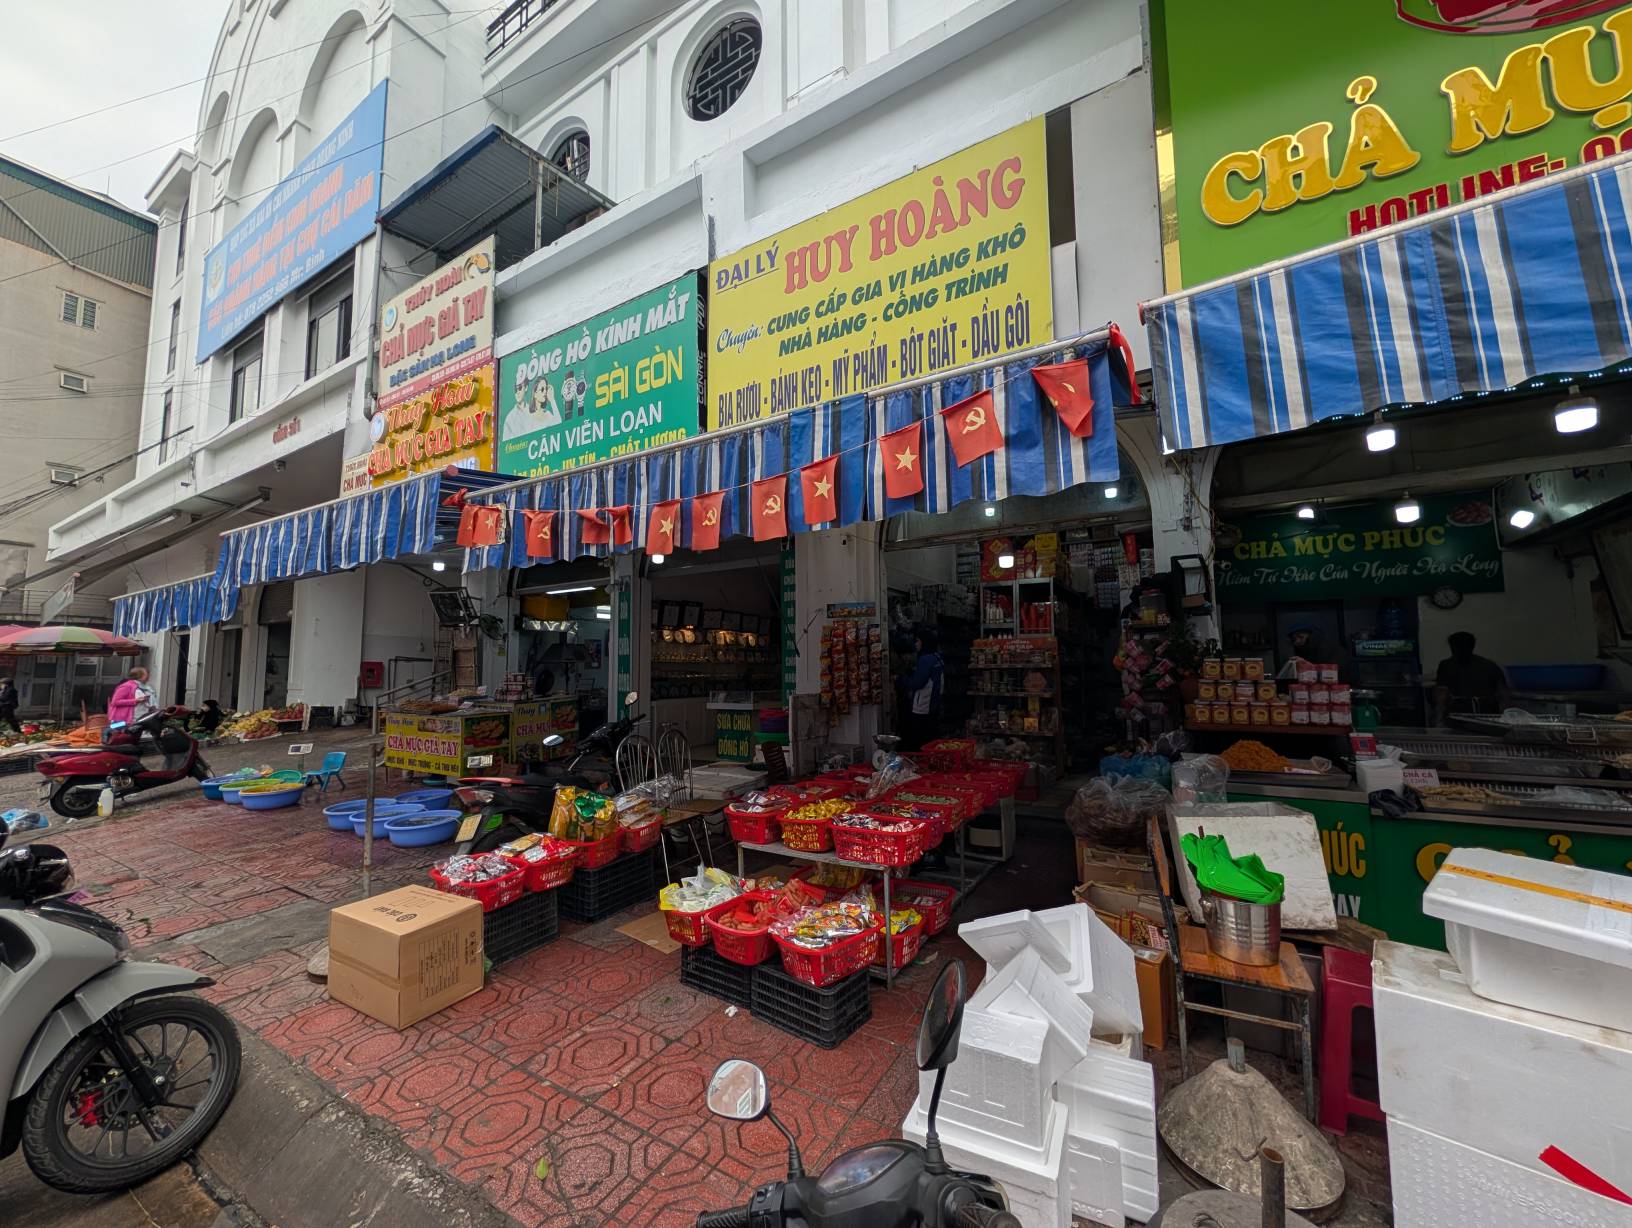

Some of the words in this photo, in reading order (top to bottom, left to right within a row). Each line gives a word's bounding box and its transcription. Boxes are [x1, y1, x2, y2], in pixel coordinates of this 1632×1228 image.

[1201, 75, 1421, 227] CHẢ
[784, 225, 859, 294] HUY
[868, 156, 1025, 261] HOÀNG
[715, 259, 750, 290] ĐẠI
[756, 240, 780, 274] LÝ
[767, 306, 810, 335] CUNG
[815, 287, 847, 318] CẤP
[851, 280, 882, 305] GIA
[889, 270, 907, 289] VỊ
[911, 248, 970, 285] HÀNG
[976, 222, 1026, 262] KHÔ
[382, 323, 405, 368] CHẢ
[407, 316, 436, 357] MỰC
[463, 286, 488, 326] TAY
[515, 348, 562, 383] ĐỒNG
[565, 327, 592, 366] HỒ
[595, 313, 642, 354] KÍNH
[644, 285, 690, 334] MẮT
[779, 327, 812, 357] NHÀ
[816, 313, 867, 344] HÀNG
[883, 288, 939, 322] CÔNG
[944, 263, 1009, 300] TRÌNH
[595, 361, 628, 408] SÀI
[636, 345, 683, 394] GÒN
[718, 392, 733, 428] BIA
[770, 368, 798, 414] BÁNH
[833, 349, 850, 397] MỸ
[853, 331, 887, 391] PHẨM
[971, 297, 1000, 359] DẦU
[368, 437, 391, 475] CHẢ
[454, 410, 486, 447] TAY
[528, 431, 561, 461] CẬN
[565, 419, 604, 449] VIỄN
[609, 401, 662, 437] LOẠN
[1233, 532, 1287, 559] CHẢ
[1294, 532, 1356, 559] MỰC
[1450, 553, 1501, 578] Long
[388, 731, 404, 750] CHẢ
[441, 741, 458, 756] TAY
[1322, 822, 1366, 878] ÚC
[1335, 893, 1361, 920] AY
